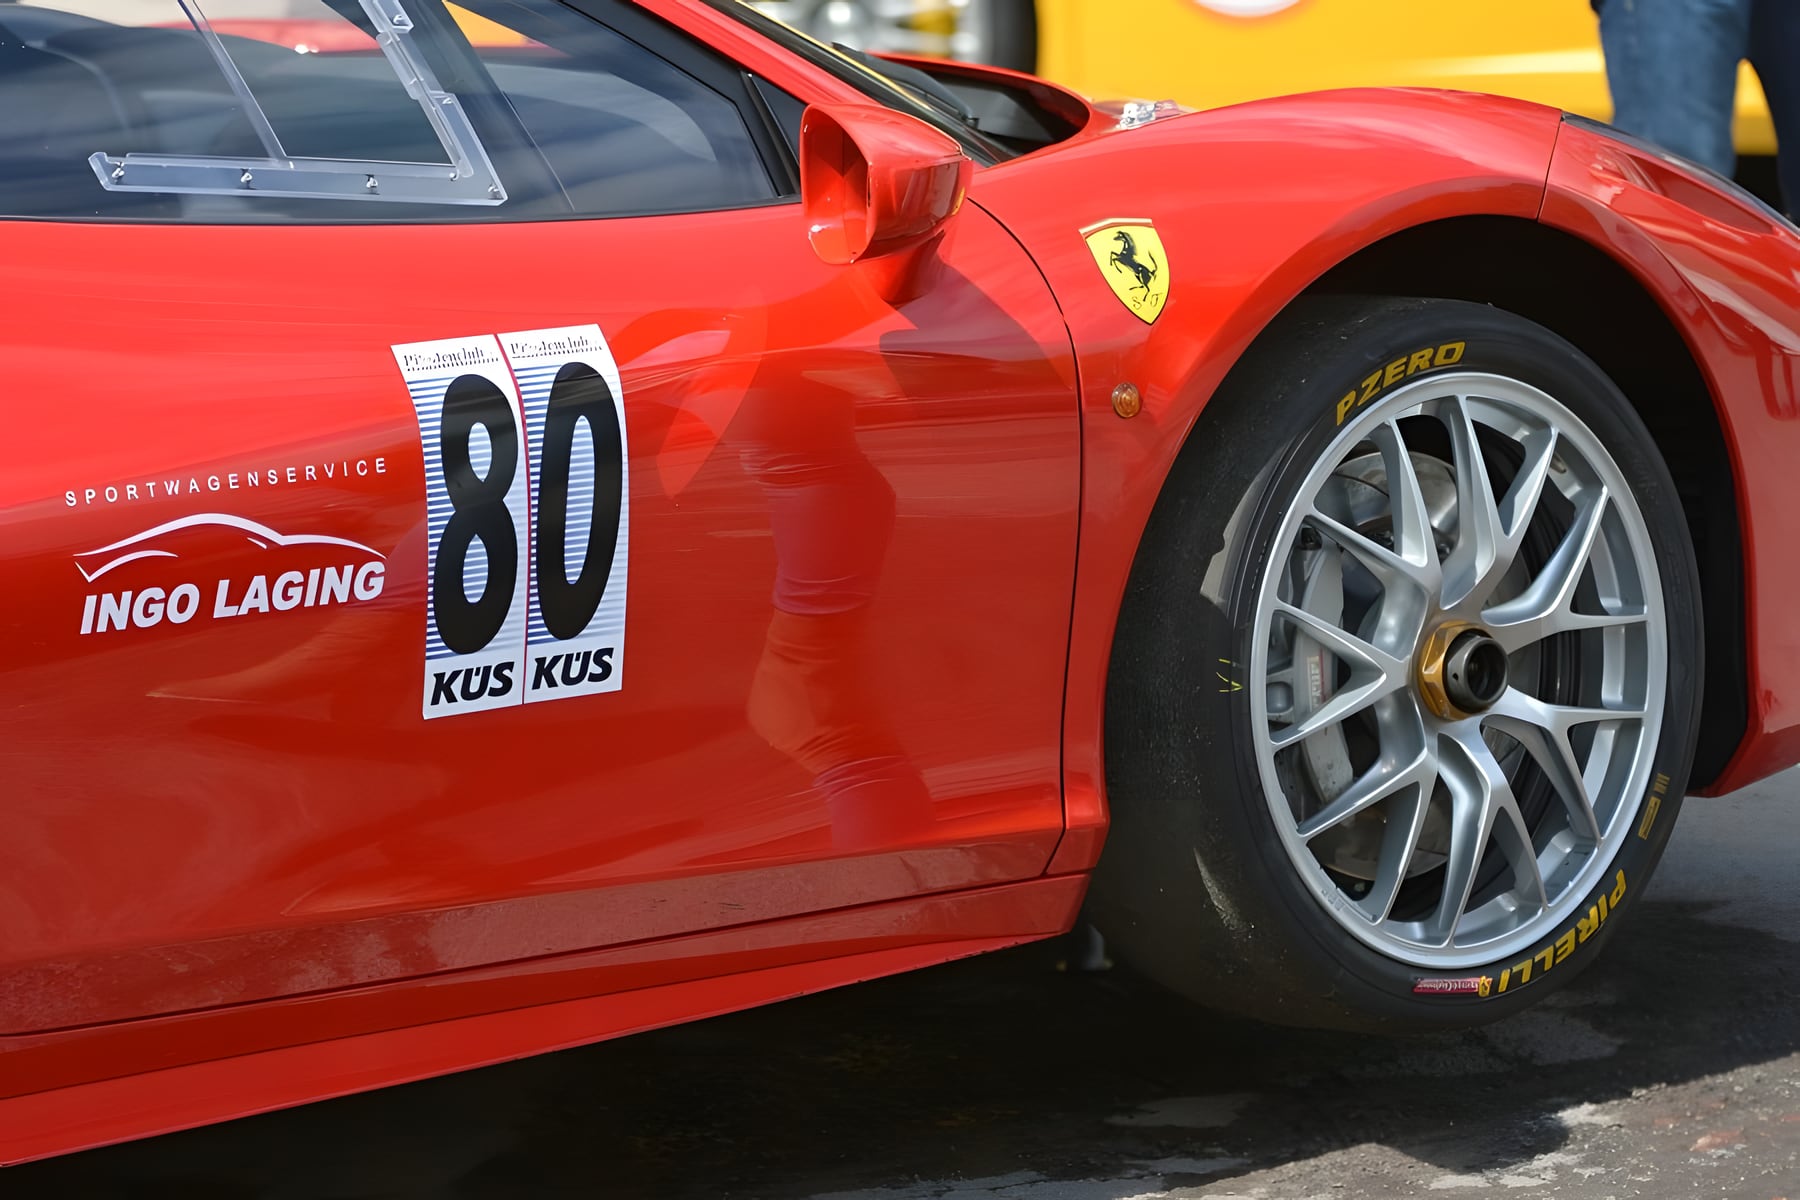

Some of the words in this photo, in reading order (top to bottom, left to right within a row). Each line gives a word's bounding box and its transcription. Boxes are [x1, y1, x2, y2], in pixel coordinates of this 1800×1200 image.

[65, 457, 387, 506] SPORTWAGENSERVICE
[433, 361, 623, 655] 80
[80, 583, 200, 635] INGO
[212, 561, 386, 618] LAGING
[430, 660, 515, 706] KÜS
[531, 646, 615, 690] KÜS
[1498, 868, 1627, 993] PIRELLI
